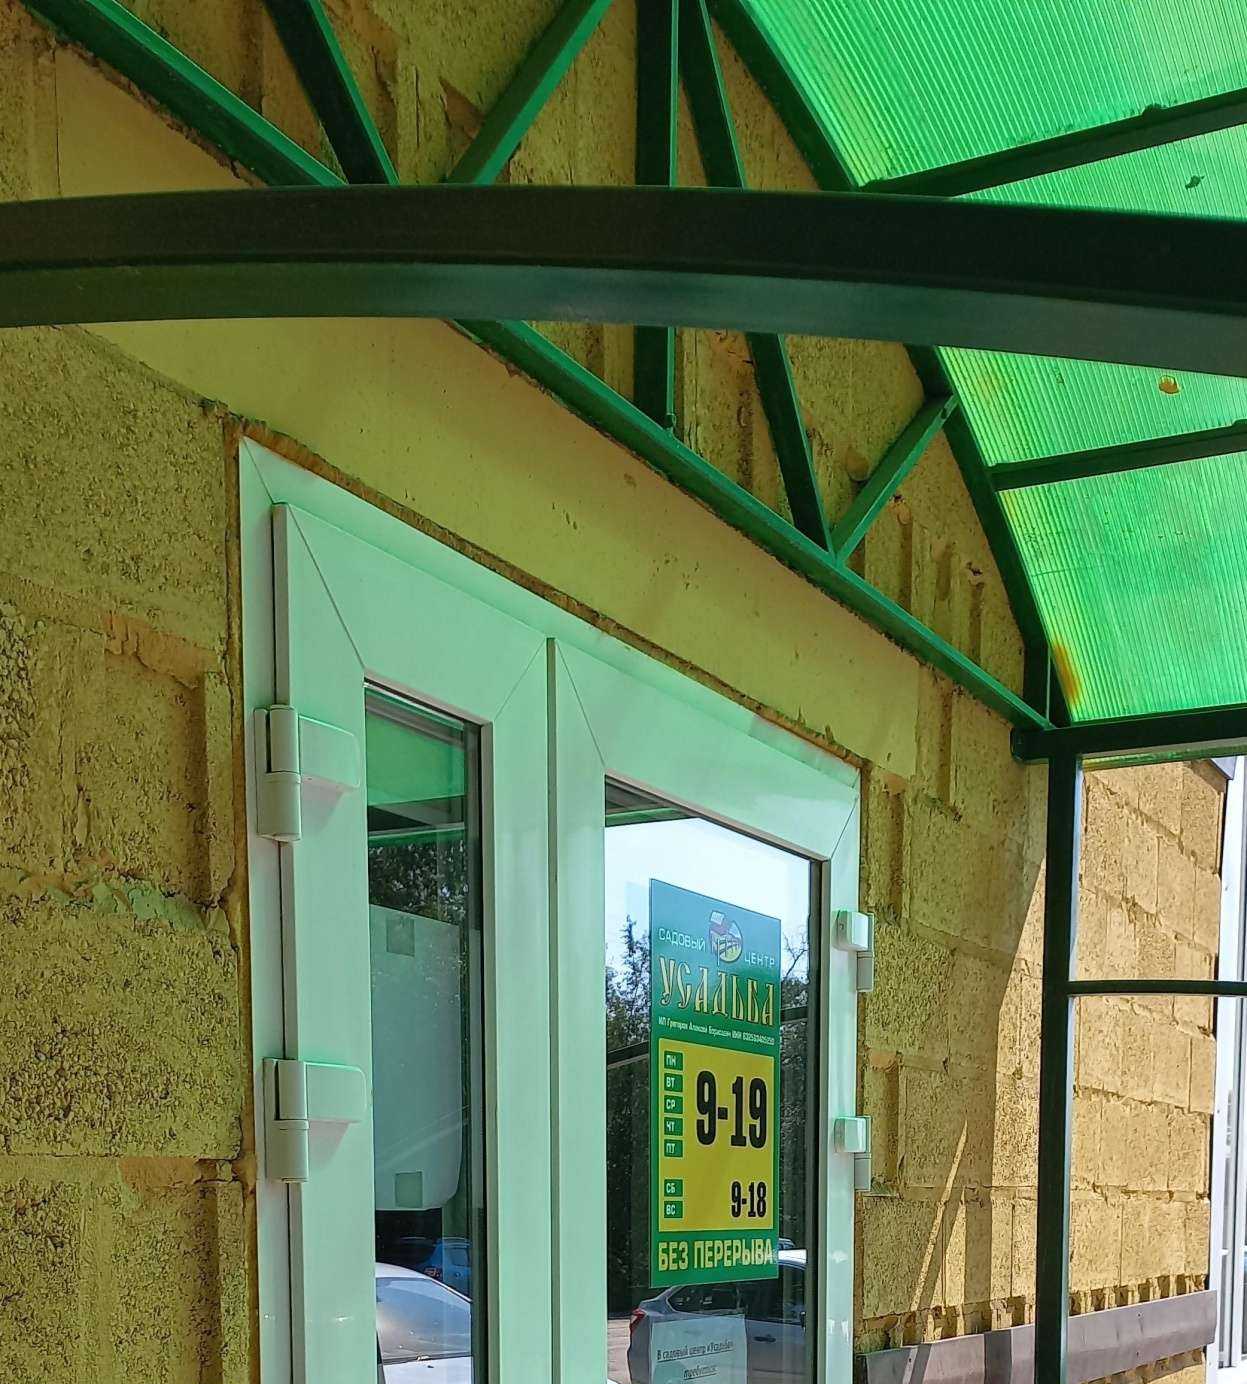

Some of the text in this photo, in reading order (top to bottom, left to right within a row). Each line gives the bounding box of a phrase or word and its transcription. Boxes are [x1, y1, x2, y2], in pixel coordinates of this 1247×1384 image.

[658, 928, 775, 967] САДОВЫЙ ЦЕНТР
[658, 955, 775, 1027] УСАДЬБА
[666, 1054, 676, 1067] ПН
[666, 1076, 675, 1088] ВТ
[666, 1098, 676, 1110] СР
[696, 1070, 767, 1149] 9-19
[666, 1120, 675, 1133] ЧТ
[666, 1142, 675, 1155] ПТ
[666, 1182, 676, 1194] СБ
[731, 1181, 767, 1218] 9-18
[666, 1204, 676, 1216] ВС
[658, 1238, 773, 1271] БЕЗ ПЕРЕРЫВА
